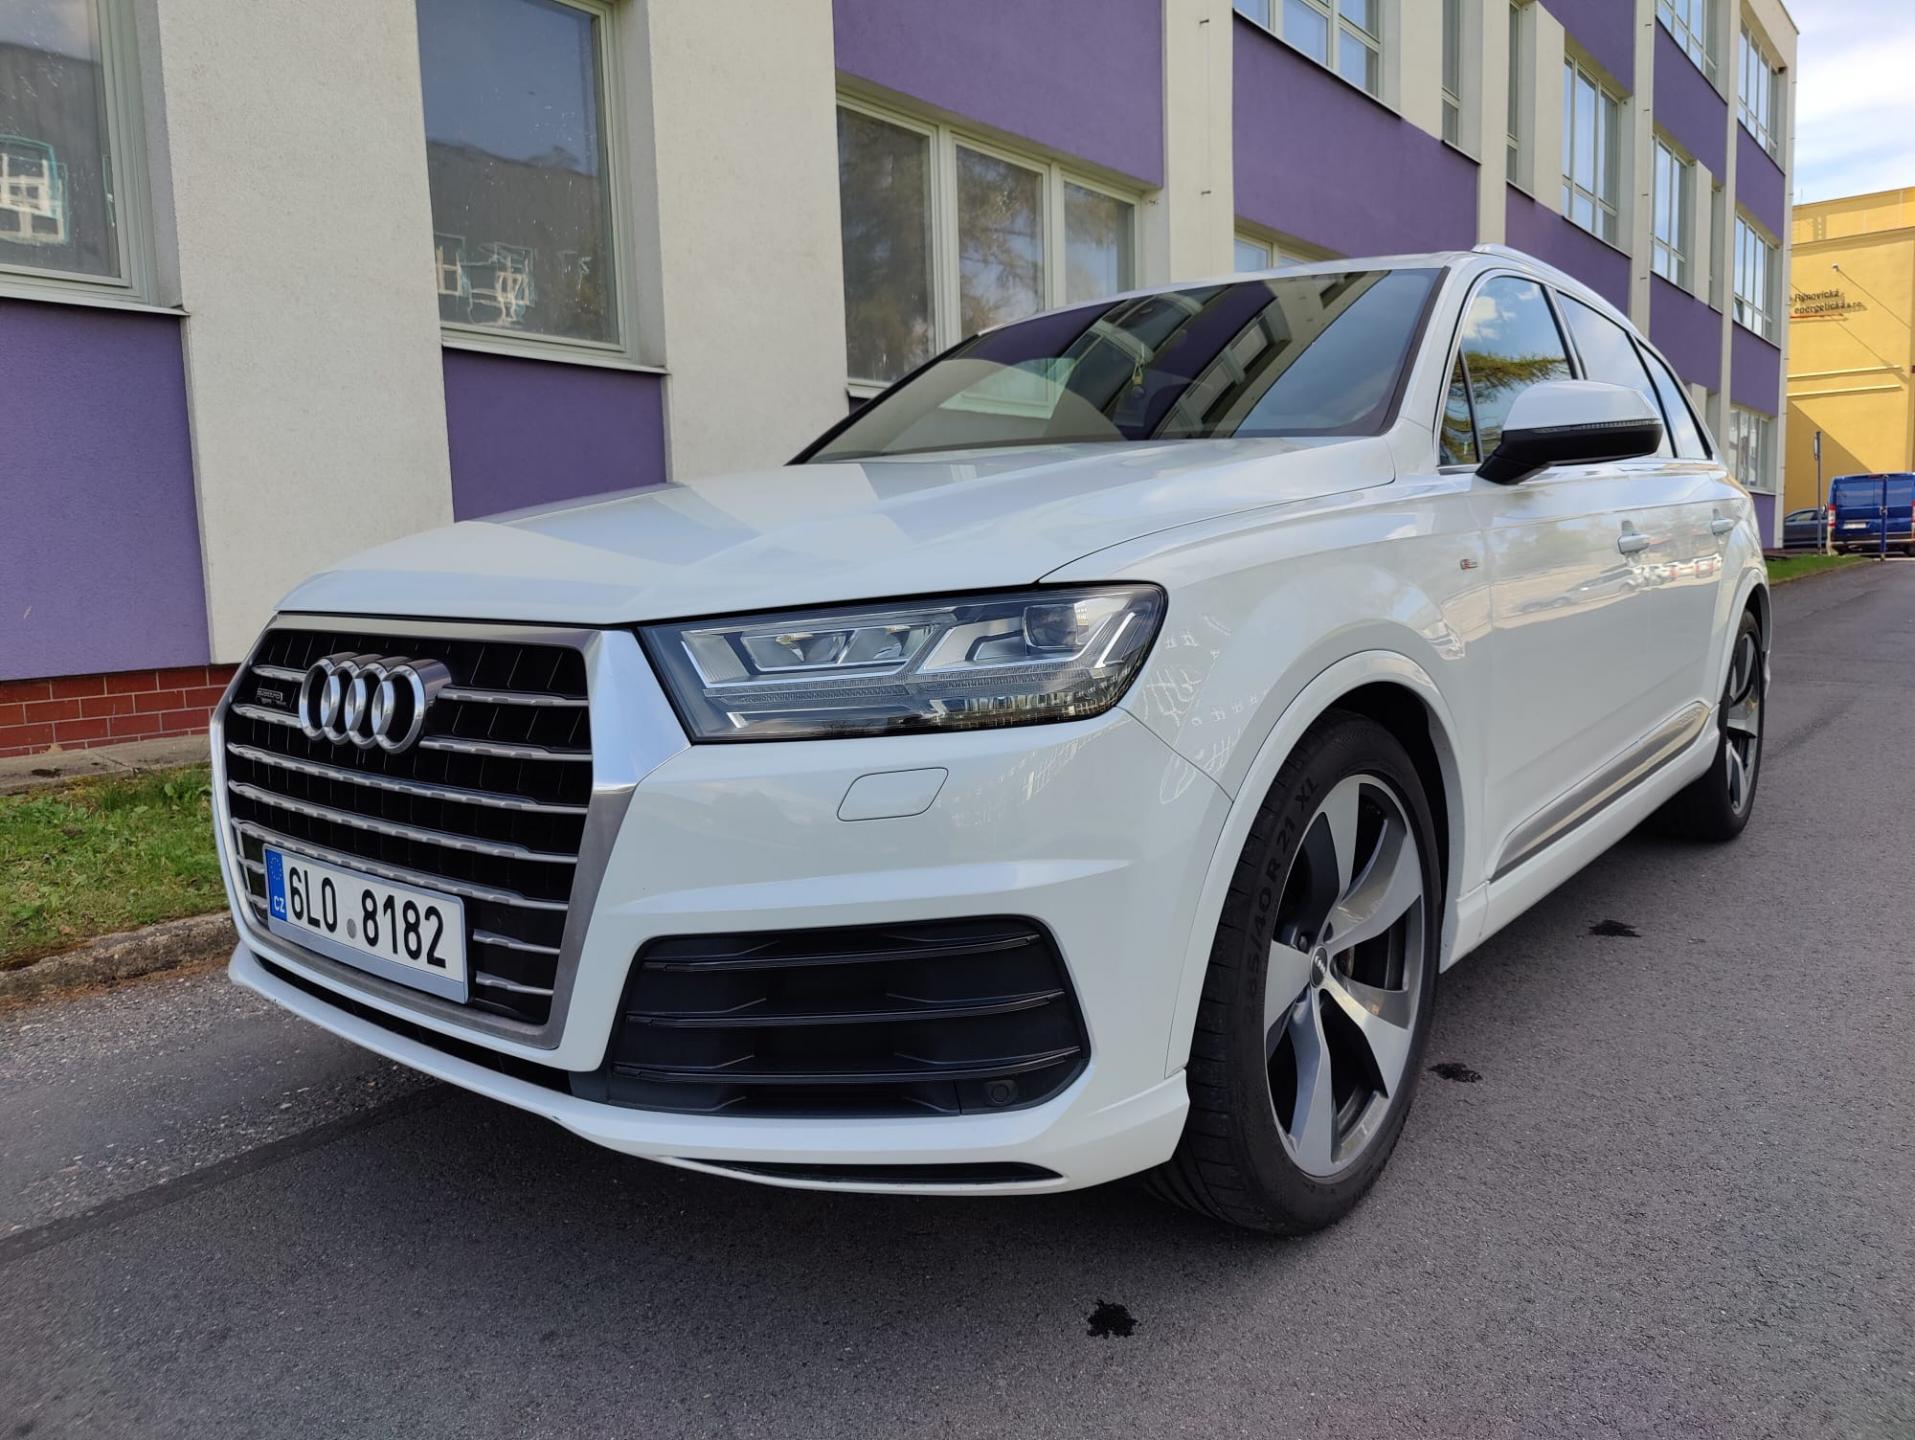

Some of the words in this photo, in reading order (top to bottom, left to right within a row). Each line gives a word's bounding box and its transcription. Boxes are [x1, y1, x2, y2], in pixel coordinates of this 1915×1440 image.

[1266, 857, 1281, 882] R
[1277, 816, 1297, 854] 21
[1295, 777, 1319, 812] XL
[273, 895, 286, 914] CZ
[362, 888, 447, 969] 8182
